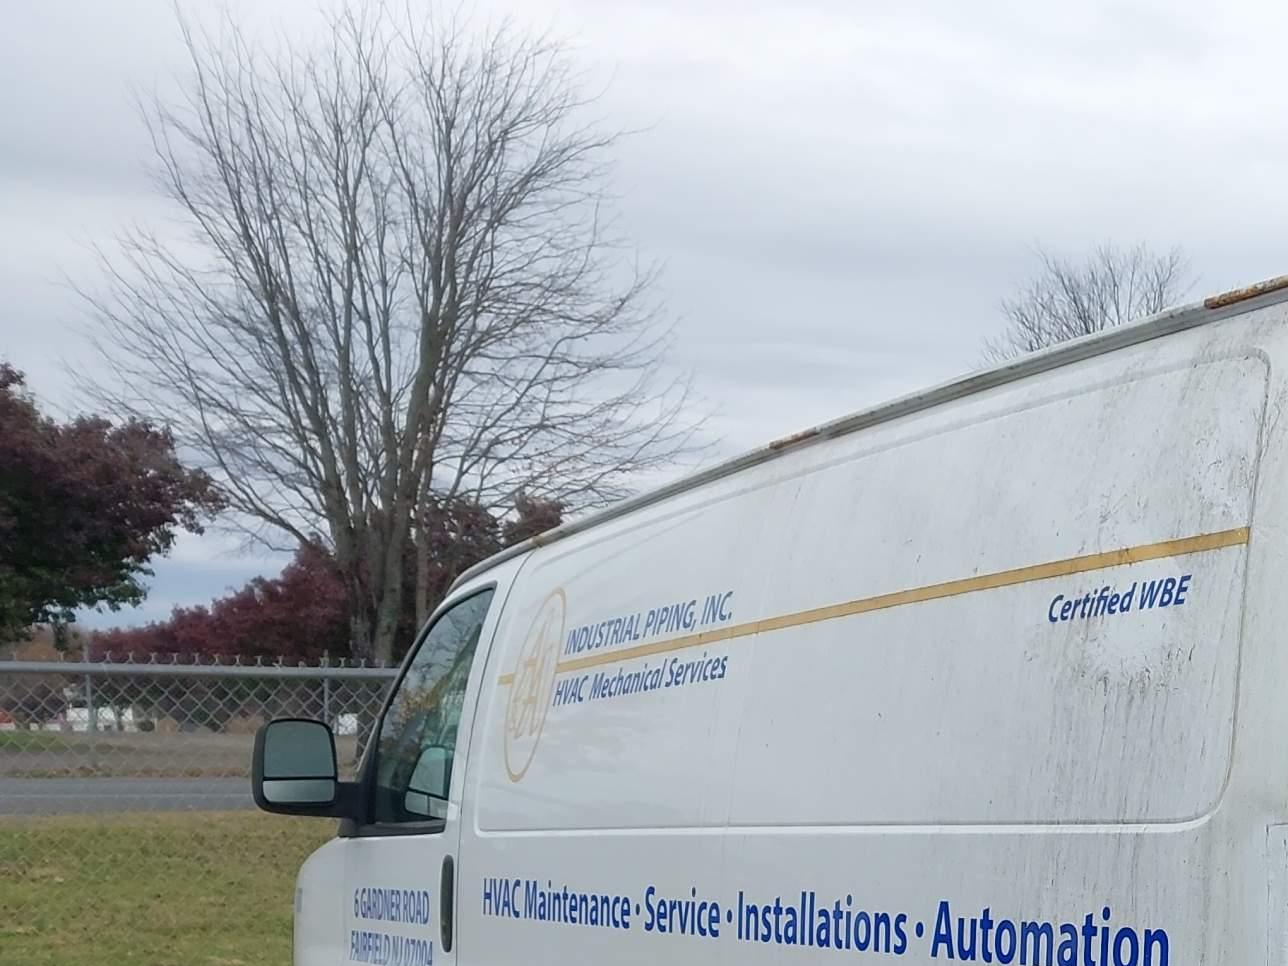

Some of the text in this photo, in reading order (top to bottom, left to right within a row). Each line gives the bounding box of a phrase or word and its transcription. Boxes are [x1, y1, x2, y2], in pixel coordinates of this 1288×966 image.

[564, 591, 733, 655] INDUSTRIAL PIPING, INC.
[1049, 575, 1192, 622] Certified WBE
[553, 652, 728, 706] HVAC Mechanical Services
[354, 888, 430, 925] 6 GARDNER ROAD
[482, 878, 521, 918] HVAC
[524, 880, 631, 929] Maintenance
[644, 886, 720, 938] Service
[738, 891, 907, 955] Installations
[350, 930, 391, 966] FAIRFIELD
